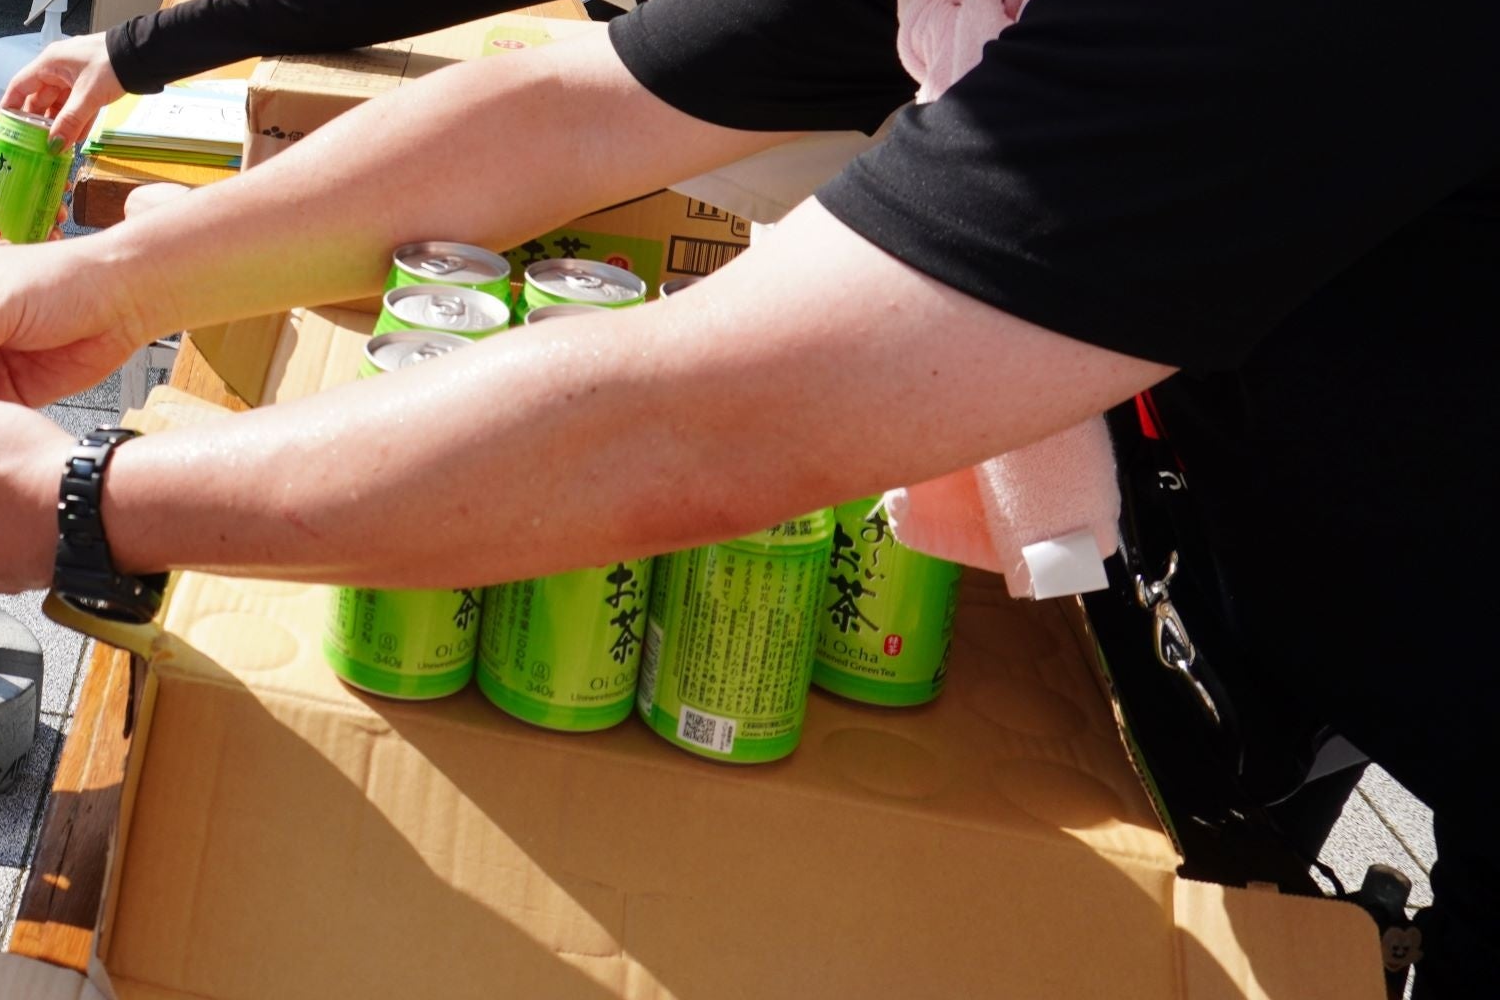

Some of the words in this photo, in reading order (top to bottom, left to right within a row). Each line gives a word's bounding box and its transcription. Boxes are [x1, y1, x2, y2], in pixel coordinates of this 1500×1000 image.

[604, 562, 643, 664] お茶
[435, 642, 454, 658] Oi
[833, 639, 879, 664] Ocha
[373, 652, 403, 669] 340g
[850, 660, 881, 676] Green
[880, 667, 896, 678] Tea
[525, 680, 555, 699] 340g
[589, 676, 610, 691] Oi
